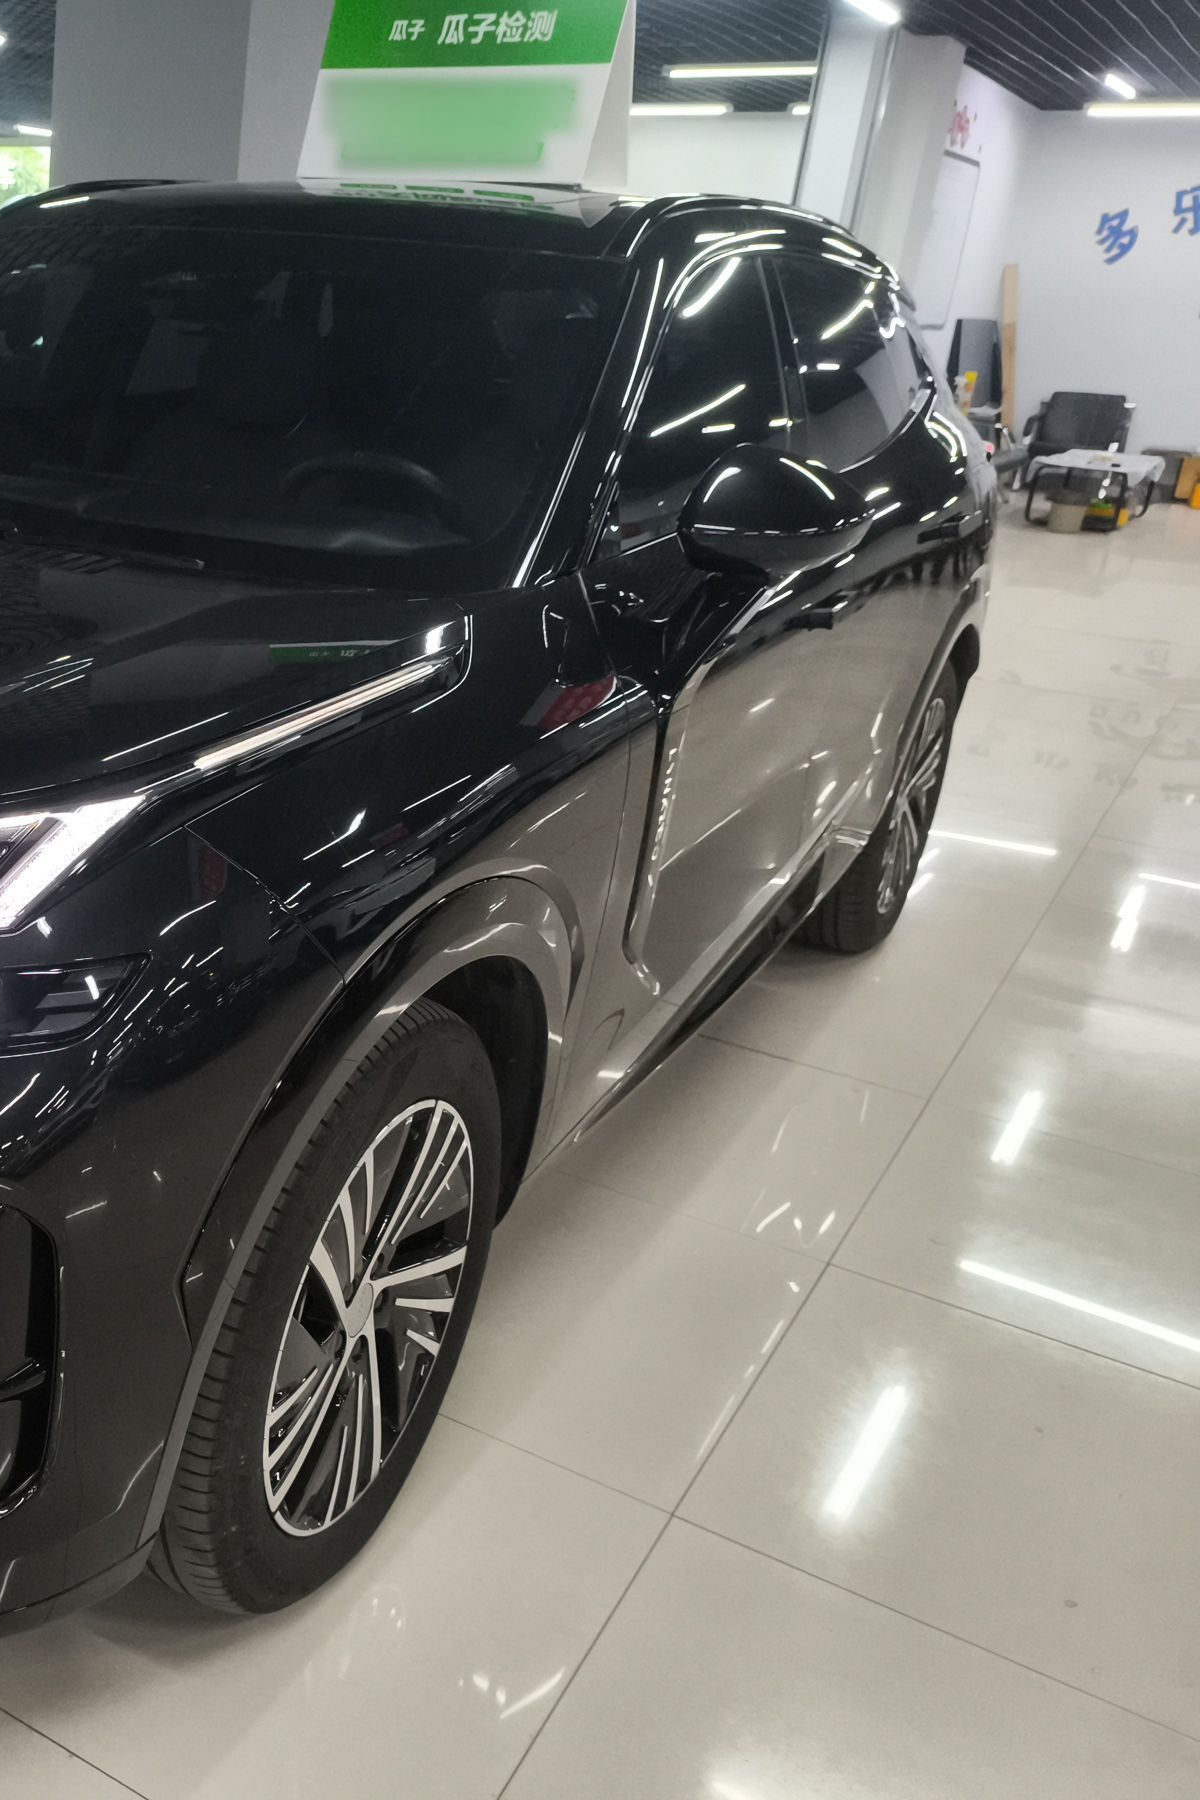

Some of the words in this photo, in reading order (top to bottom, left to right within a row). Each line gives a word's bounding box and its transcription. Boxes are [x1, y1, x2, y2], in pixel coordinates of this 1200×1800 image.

[388, 19, 426, 41] 瓜子
[437, 9, 558, 45] 瓜子检测
